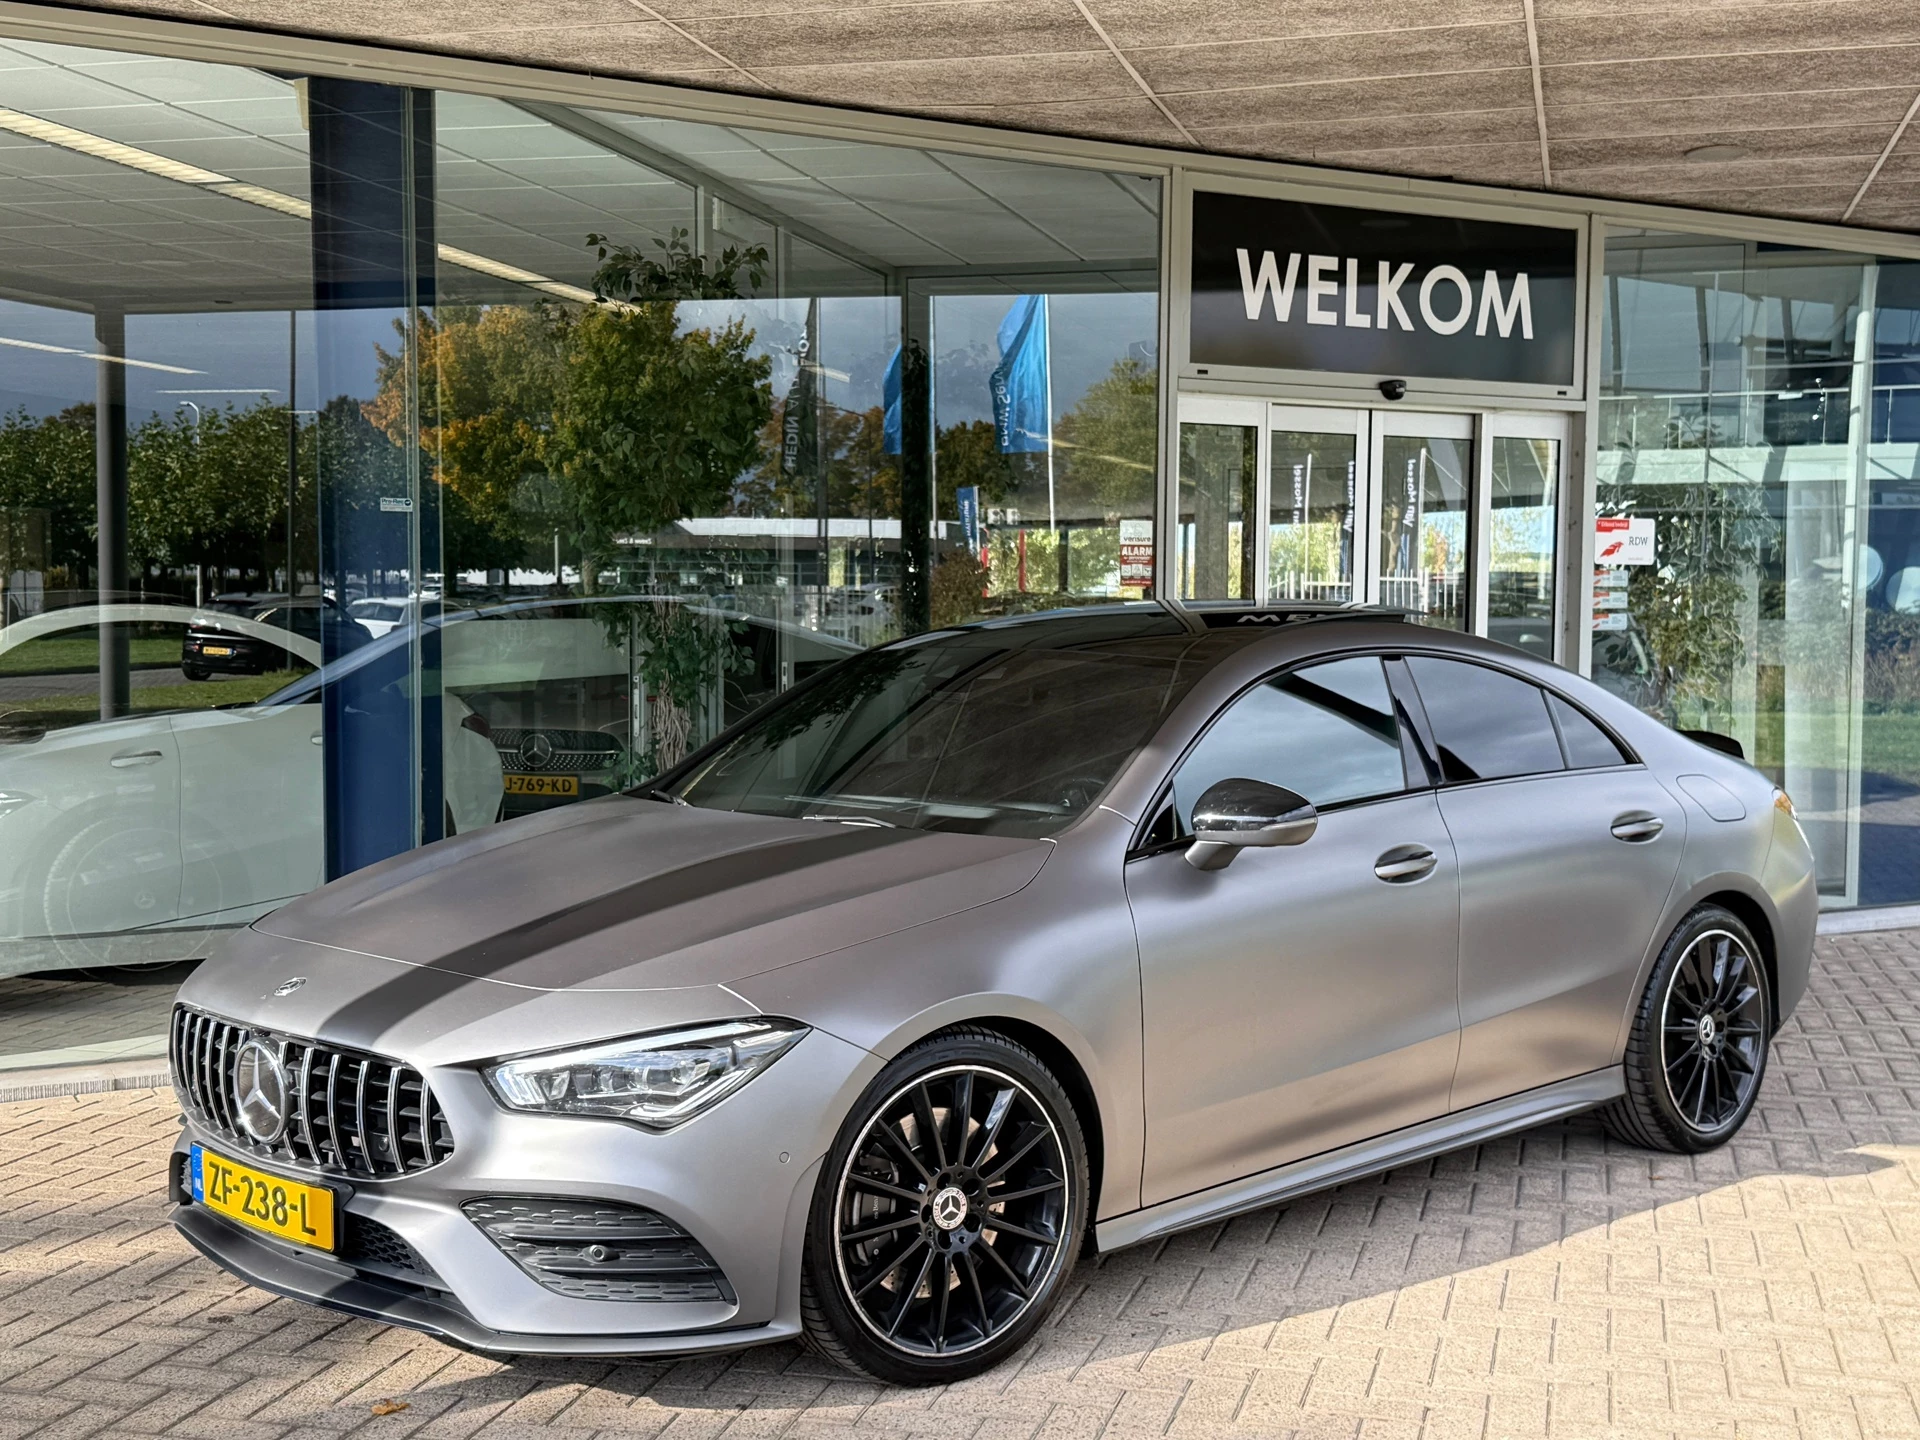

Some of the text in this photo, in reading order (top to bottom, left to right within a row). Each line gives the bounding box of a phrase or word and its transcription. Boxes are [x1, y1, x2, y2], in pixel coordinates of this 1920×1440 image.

[1236, 248, 1534, 340] WELKOM
[1628, 536, 1649, 546] RDW
[1121, 546, 1153, 556] ALARM
[505, 777, 572, 793] J-769-KD
[208, 1160, 317, 1237] ZF-238-L
